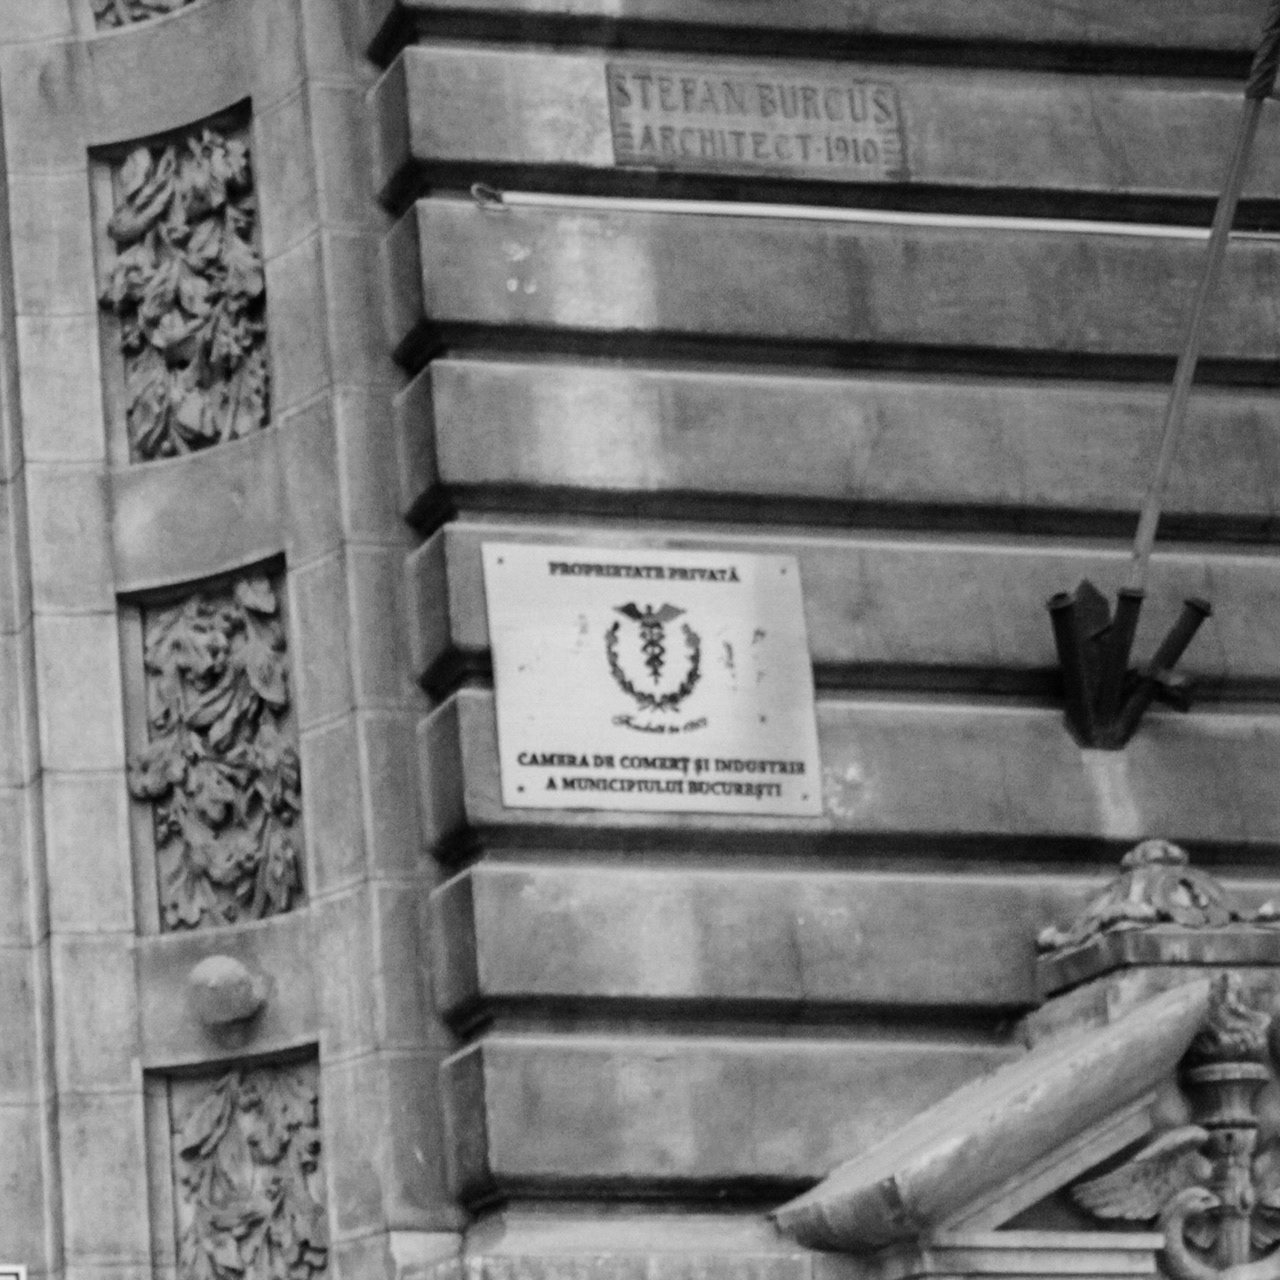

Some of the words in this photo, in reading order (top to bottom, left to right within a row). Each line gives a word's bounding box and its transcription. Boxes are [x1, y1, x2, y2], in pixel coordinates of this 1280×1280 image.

[549, 562, 665, 580] PROPRIETATE
[517, 753, 589, 768] CAMERA
[593, 754, 614, 768] DE
[714, 758, 805, 775] INDUSTRIE
[545, 777, 557, 790] A
[562, 777, 683, 794] MUNICIPIULUI
